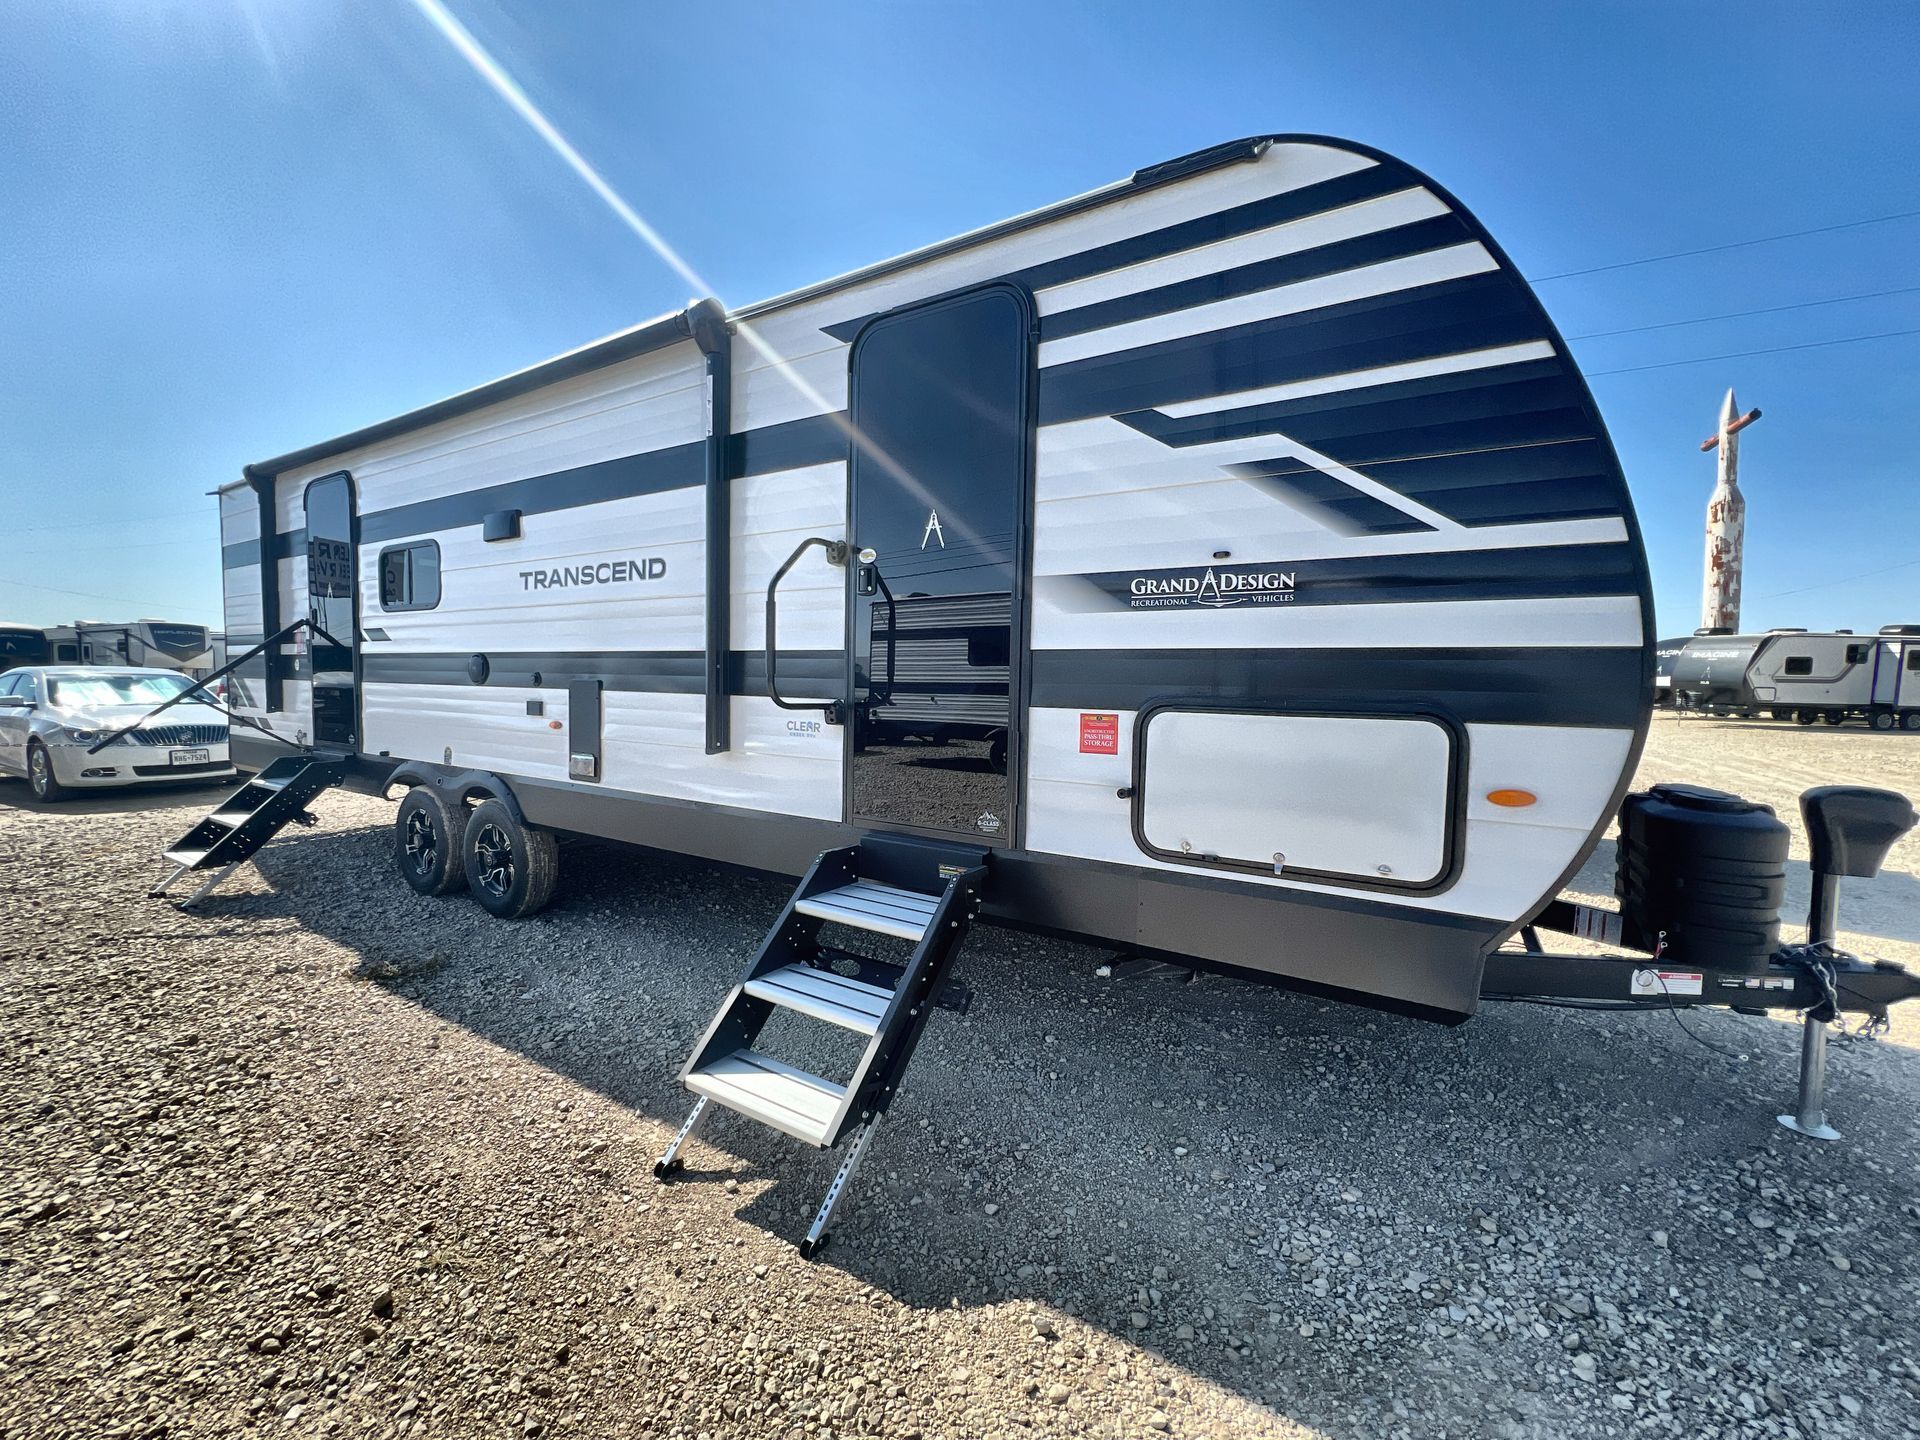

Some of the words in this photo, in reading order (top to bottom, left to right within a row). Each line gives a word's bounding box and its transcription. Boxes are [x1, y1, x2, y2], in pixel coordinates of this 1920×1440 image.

[519, 557, 667, 591] TRANSCEND
[1130, 577, 1200, 595] GRAND
[1219, 572, 1296, 591] DESIGN
[1131, 598, 1190, 607] RECREATIONAL
[1251, 594, 1295, 603] VEHICLES
[786, 720, 821, 733] CLEAR
